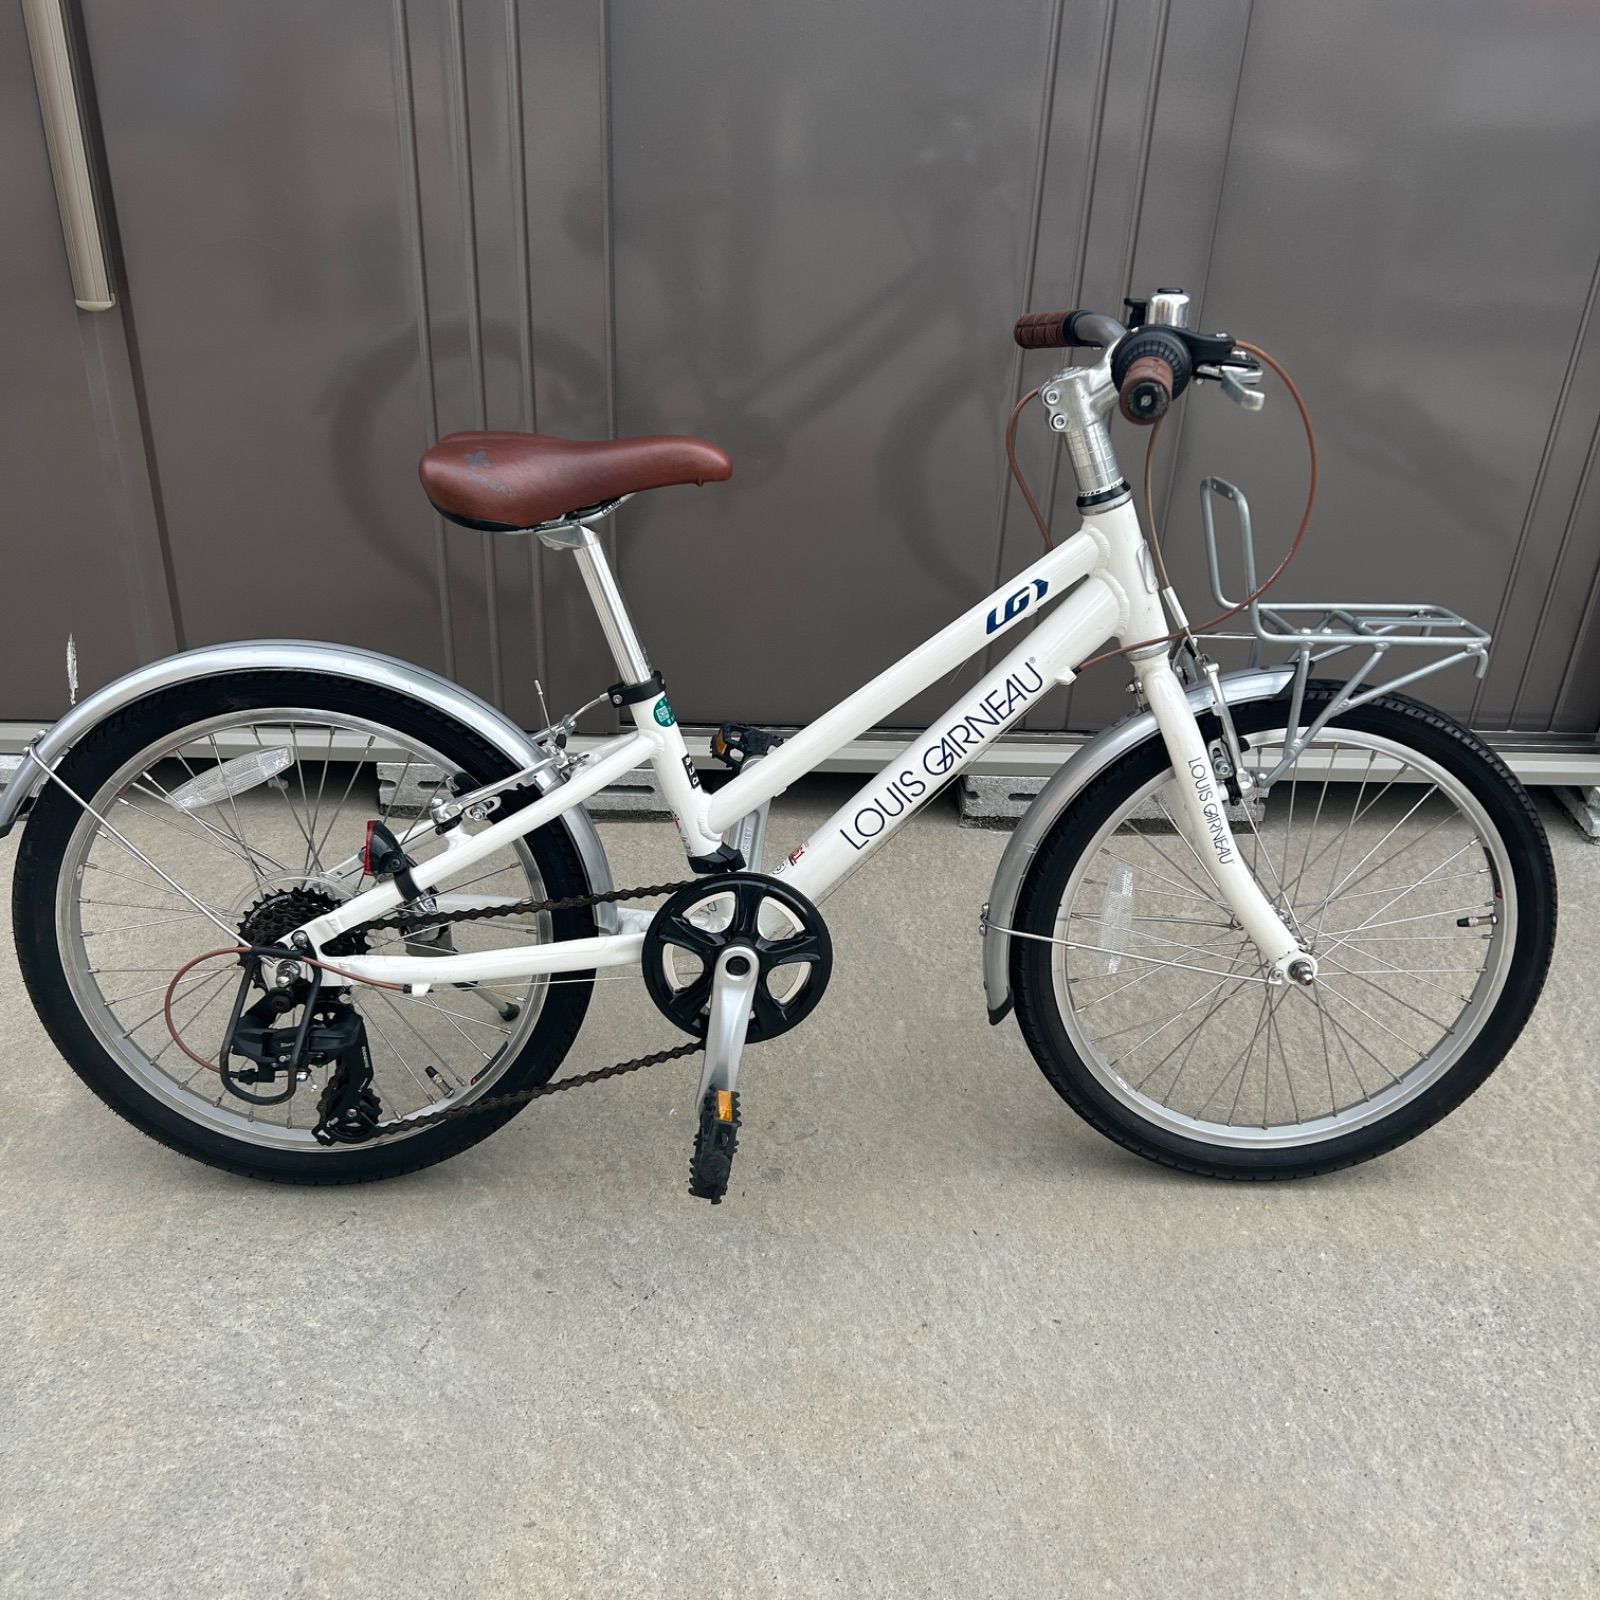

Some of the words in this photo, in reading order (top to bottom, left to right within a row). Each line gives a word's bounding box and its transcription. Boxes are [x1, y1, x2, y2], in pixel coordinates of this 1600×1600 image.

[839, 770, 926, 850] LOUIS
[923, 661, 1043, 776] GARNEAU
[1188, 757, 1214, 802] LOUIS
[1203, 803, 1234, 865] GARNEAU
